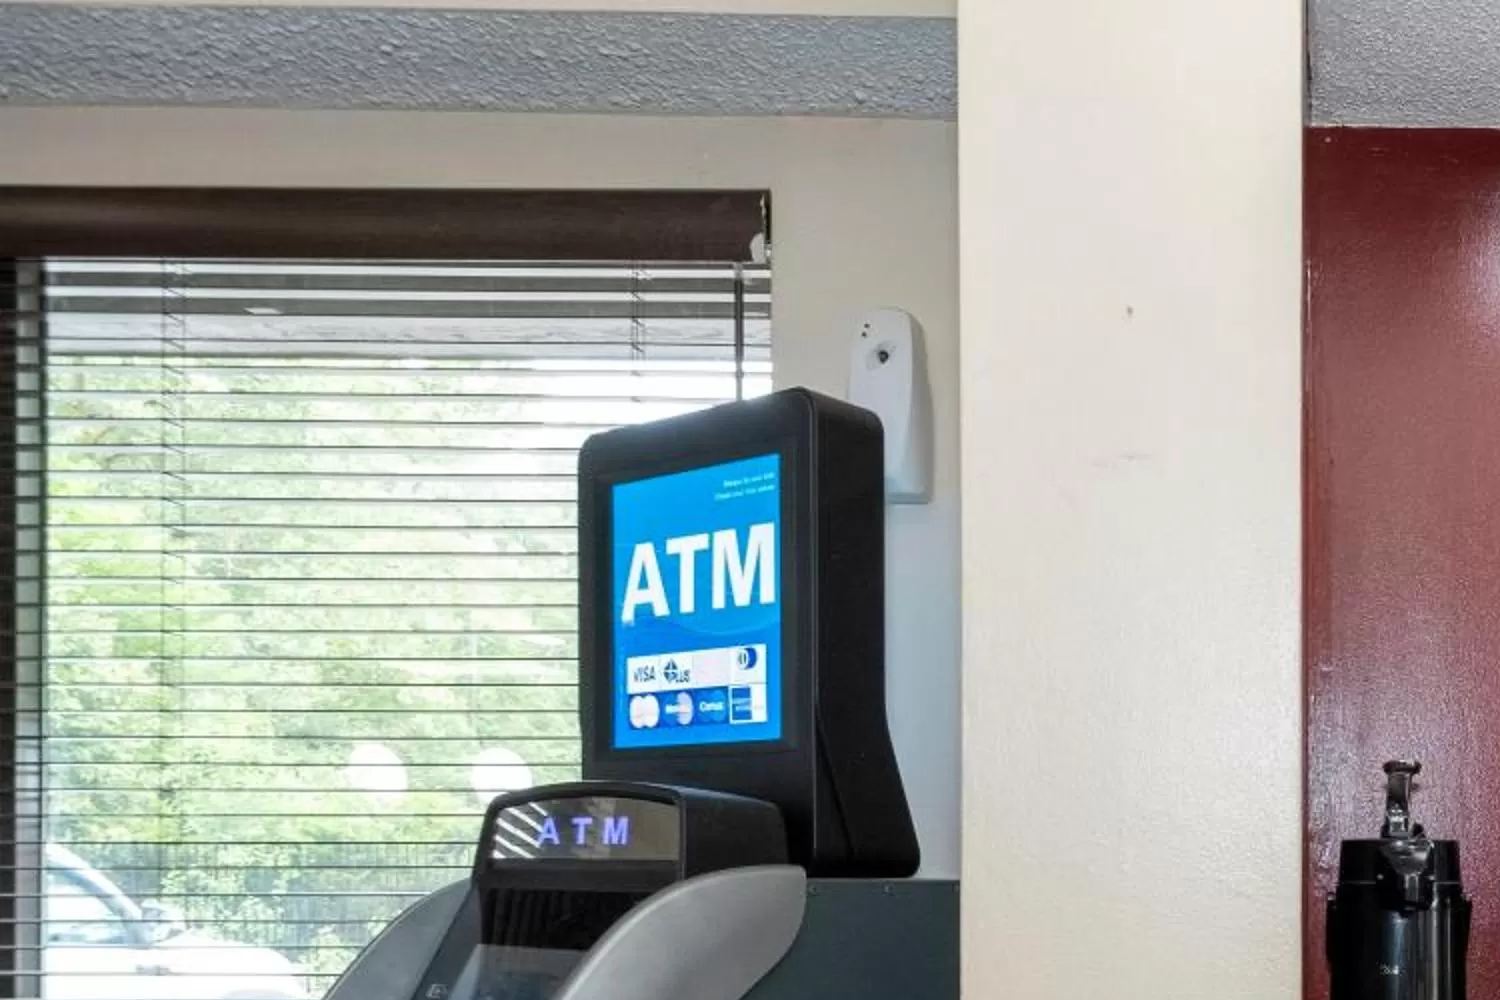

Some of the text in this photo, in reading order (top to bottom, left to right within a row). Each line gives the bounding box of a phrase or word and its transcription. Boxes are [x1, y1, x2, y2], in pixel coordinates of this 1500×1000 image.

[621, 521, 776, 627] ATM
[633, 664, 656, 683] VISA
[536, 815, 630, 846] ATM
